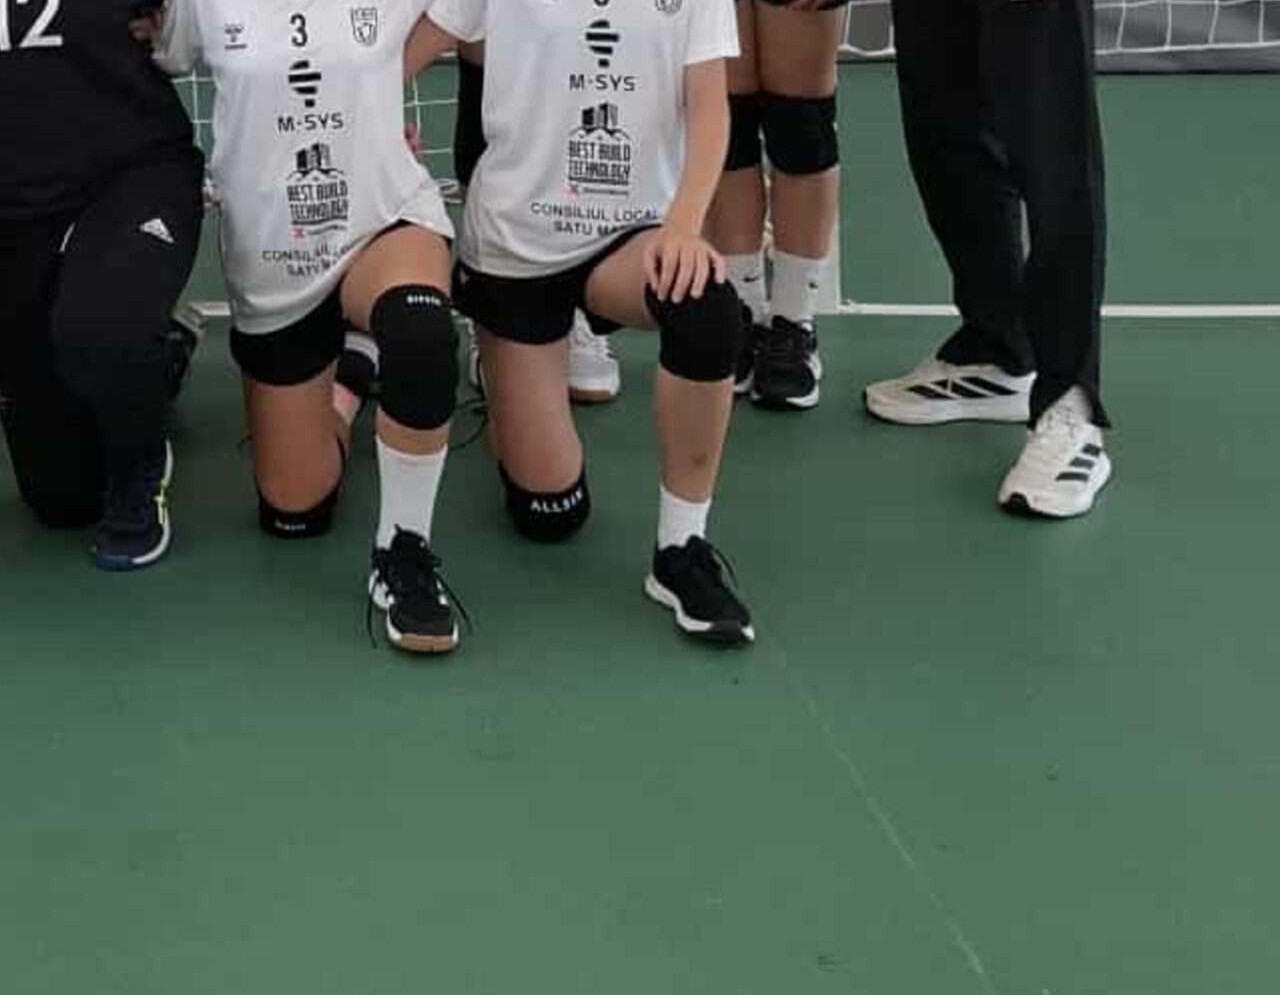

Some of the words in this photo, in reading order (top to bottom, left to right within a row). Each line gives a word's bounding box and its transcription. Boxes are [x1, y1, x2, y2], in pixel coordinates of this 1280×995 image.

[290, 13, 308, 47] 3
[530, 202, 608, 222] CONSILIUL
[613, 207, 660, 223] LOCAL
[554, 221, 593, 236] SATU
